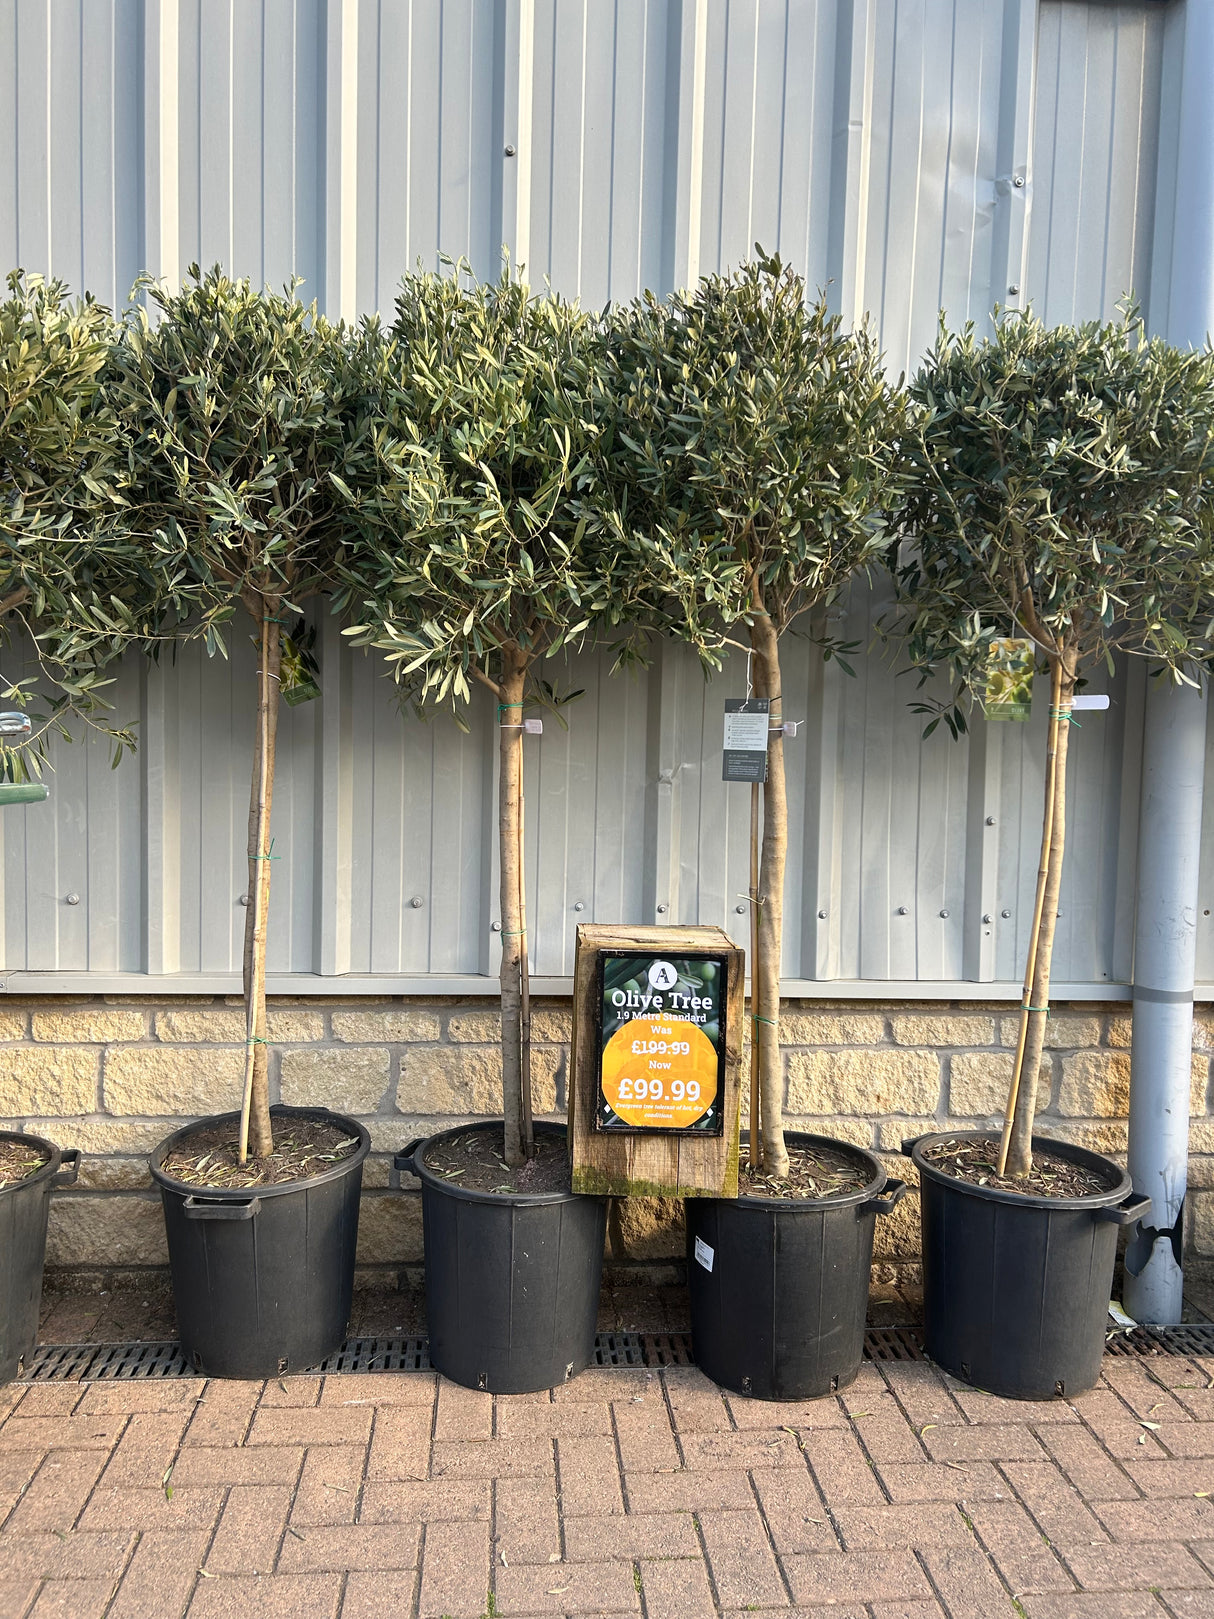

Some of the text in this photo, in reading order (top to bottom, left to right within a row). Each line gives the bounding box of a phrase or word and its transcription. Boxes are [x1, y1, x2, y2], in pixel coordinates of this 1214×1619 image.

[655, 967, 670, 984] A
[611, 990, 713, 1010] Olive Tree
[616, 1011, 707, 1023] 1.9 Metre Standard
[650, 1025, 672, 1035] Was
[631, 1040, 690, 1056] £199.99
[648, 1060, 672, 1070] Now
[618, 1078, 701, 1102] £99.99
